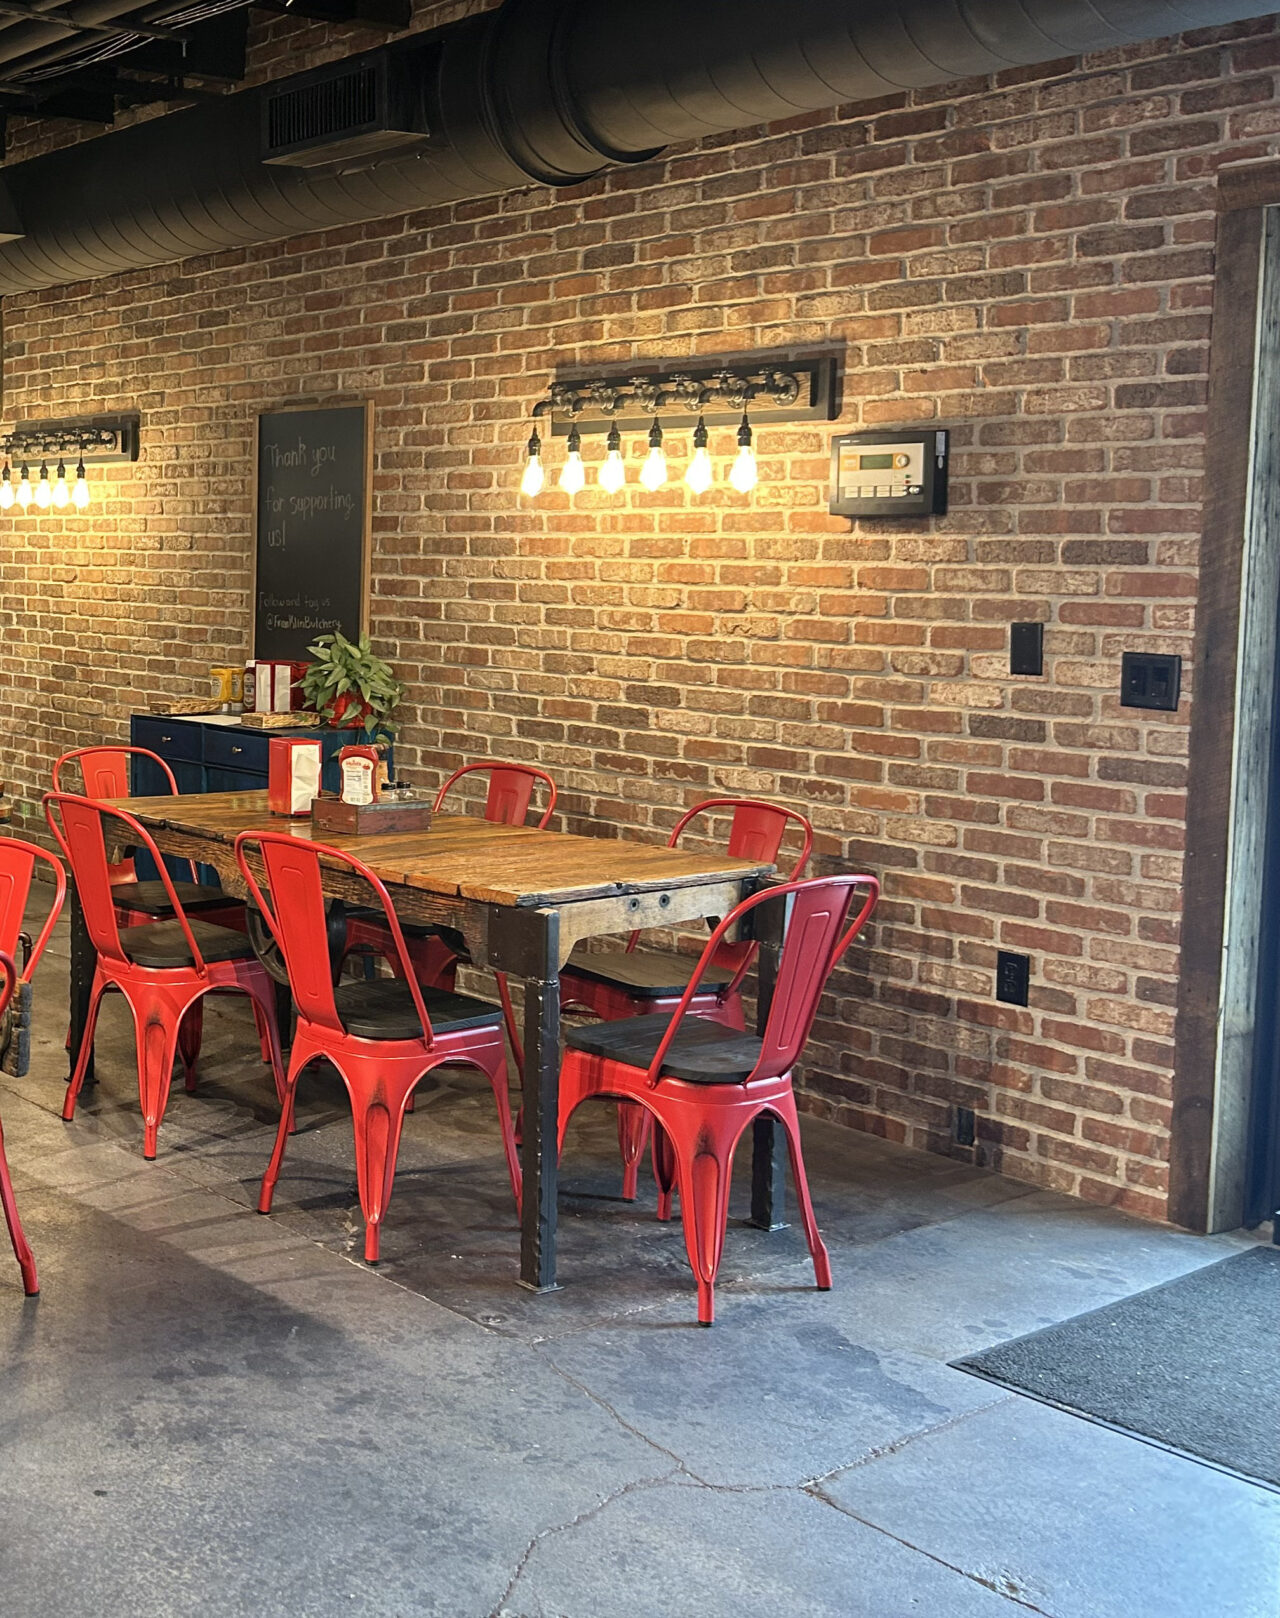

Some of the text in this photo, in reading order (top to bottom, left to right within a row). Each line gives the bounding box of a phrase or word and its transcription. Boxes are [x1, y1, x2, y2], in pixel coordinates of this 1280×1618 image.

[264, 436, 336, 477] Thank you
[264, 483, 356, 520] for supporting
[267, 519, 286, 552] us!
